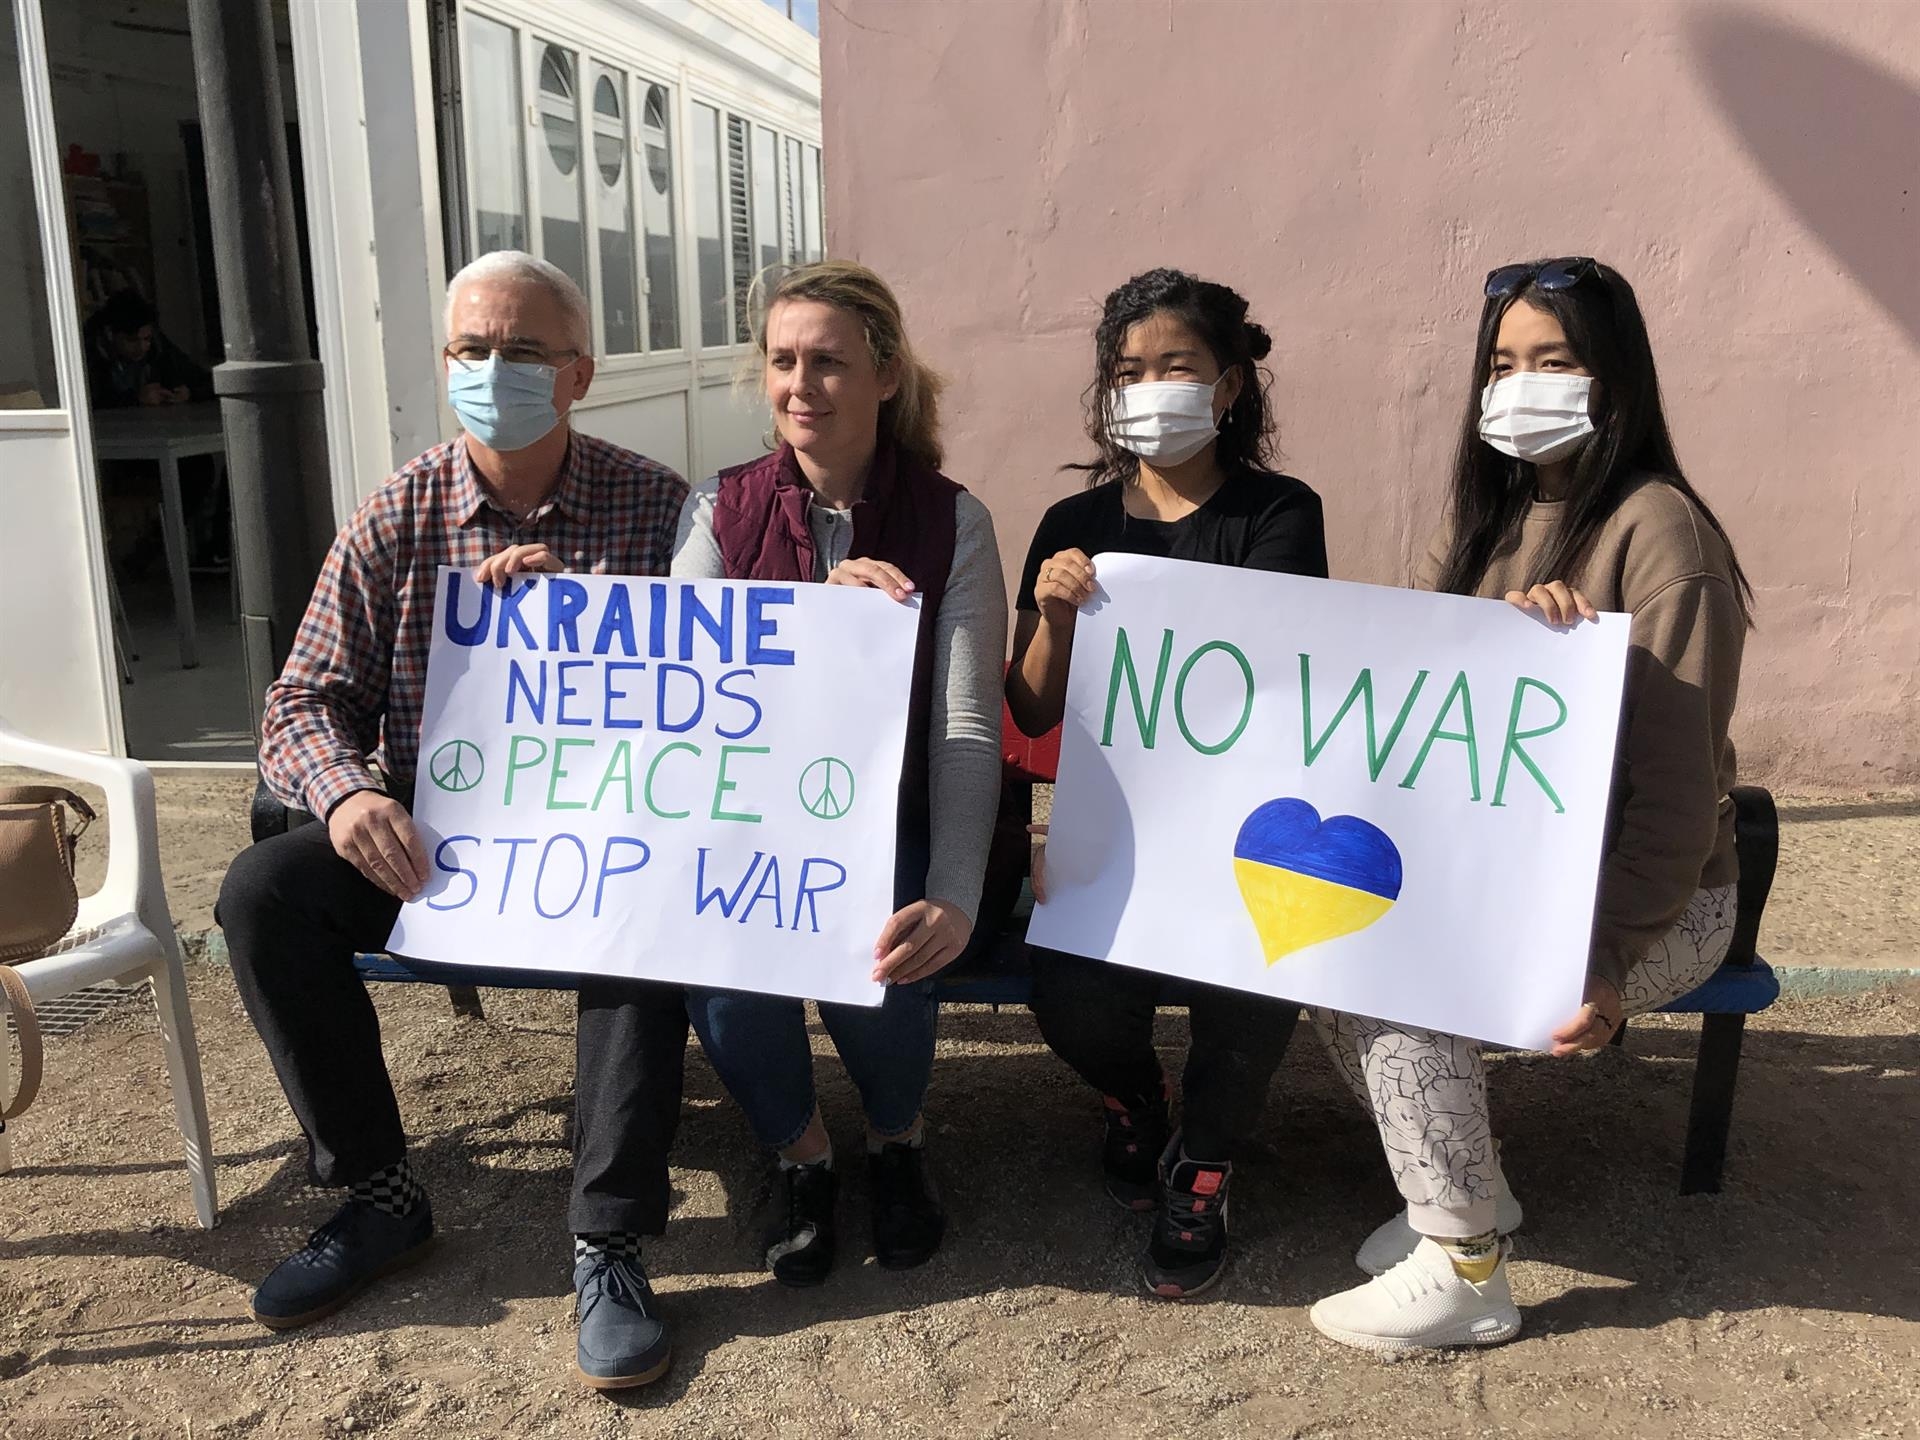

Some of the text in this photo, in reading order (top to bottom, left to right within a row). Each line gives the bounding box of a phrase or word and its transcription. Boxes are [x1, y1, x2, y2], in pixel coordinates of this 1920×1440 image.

[445, 572, 794, 665] UKRAINE
[505, 659, 763, 740] NEEDS
[1100, 627, 1568, 813] NO WAR
[503, 735, 771, 823] PEACE
[426, 833, 847, 933] STOP WAR
